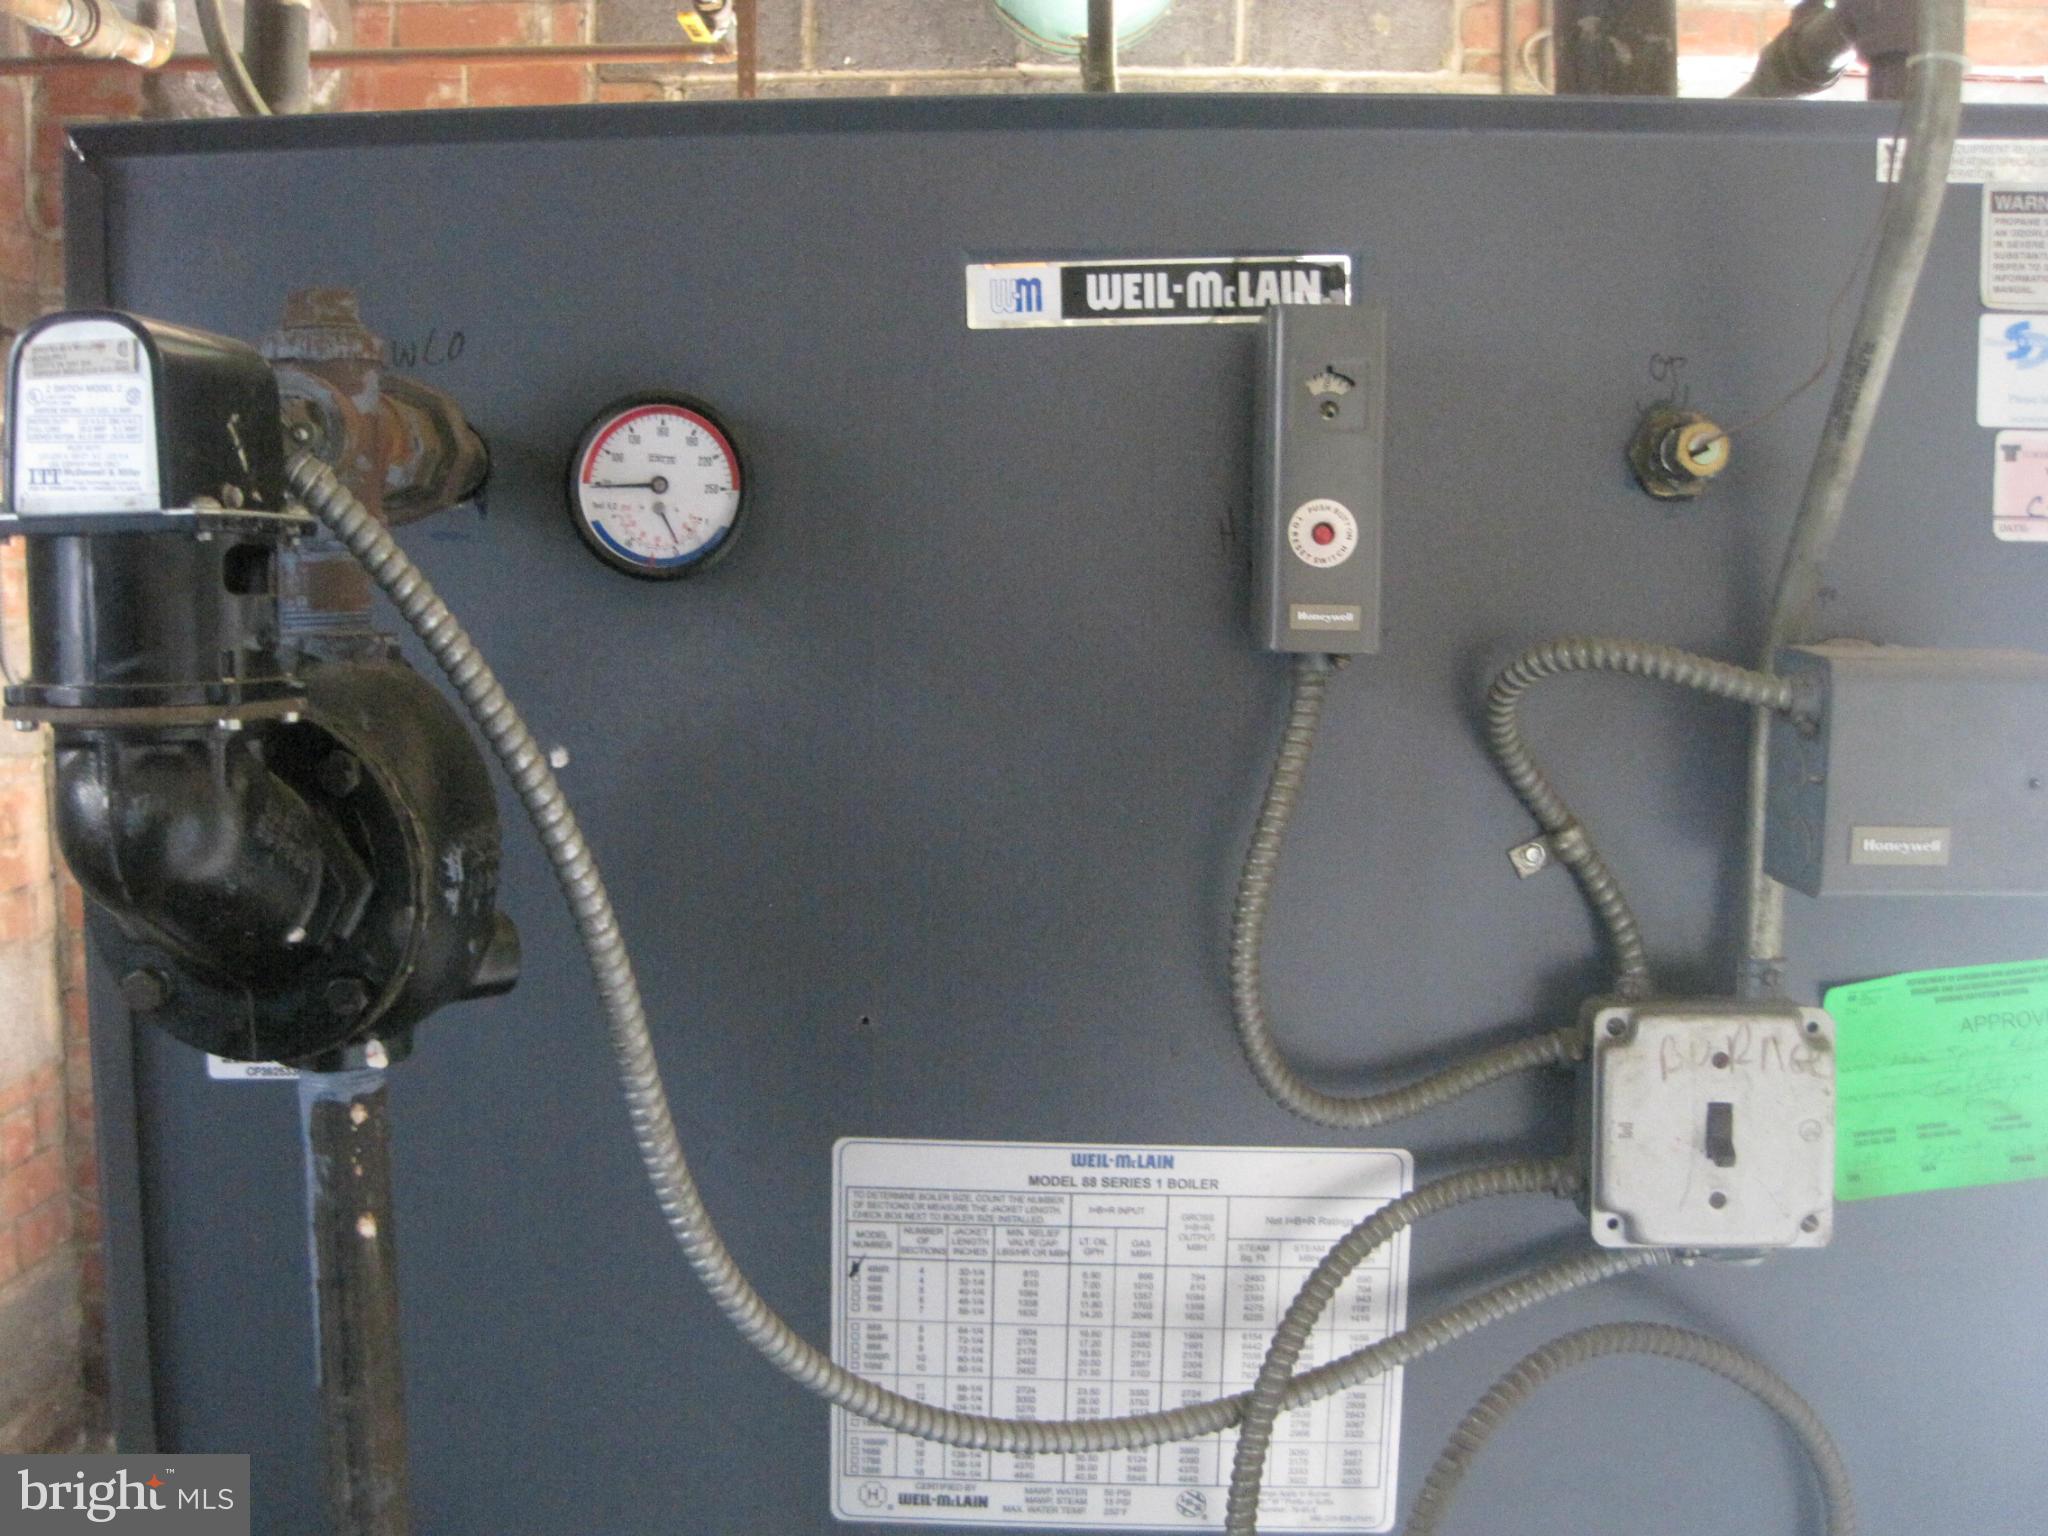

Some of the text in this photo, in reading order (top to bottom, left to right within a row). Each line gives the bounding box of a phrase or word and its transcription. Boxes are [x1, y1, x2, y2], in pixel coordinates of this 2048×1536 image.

[1297, 611, 1354, 624] Honeywell
[1863, 838, 1942, 855] Honeywell
[1071, 1153, 1174, 1170] WEIL-McLAIN
[1028, 1175, 1219, 1190] MODEL 88 SERIES 1 BOILER
